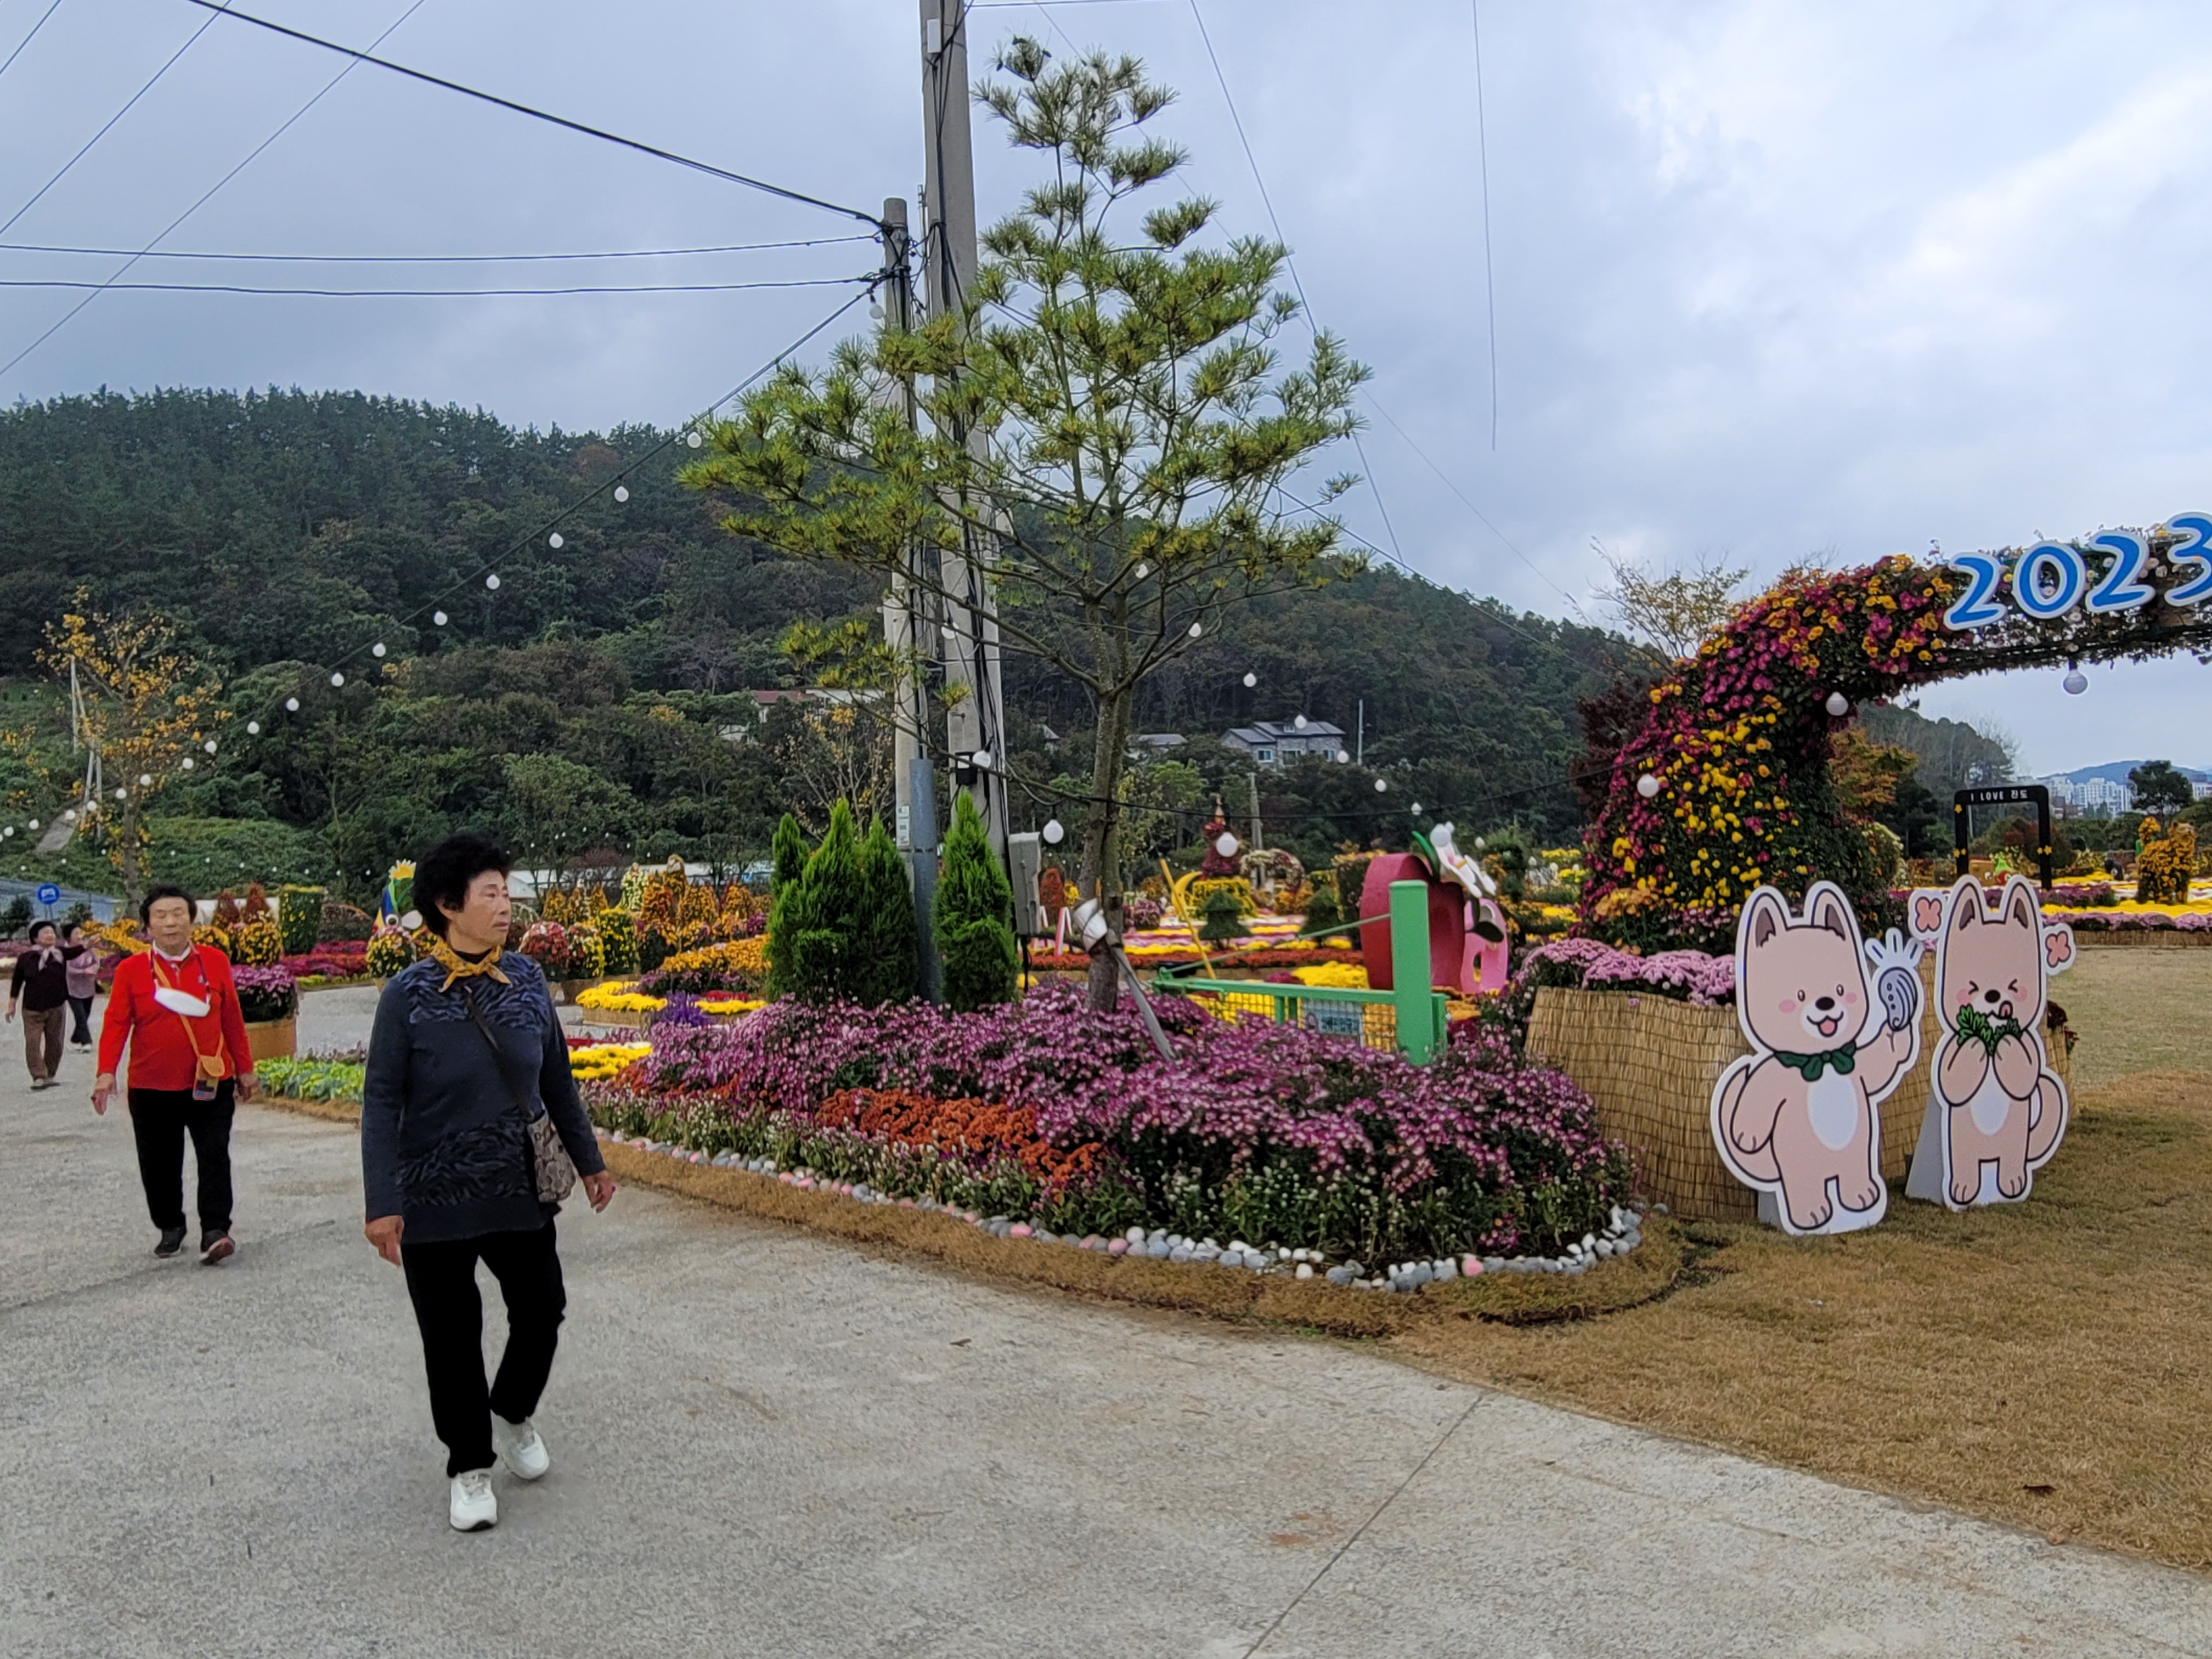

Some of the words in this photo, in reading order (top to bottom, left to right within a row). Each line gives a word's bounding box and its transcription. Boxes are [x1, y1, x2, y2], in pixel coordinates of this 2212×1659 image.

[1944, 512, 2212, 630] 2023
[1980, 791, 2004, 802] LOVE
[2011, 789, 2028, 799] 진도
